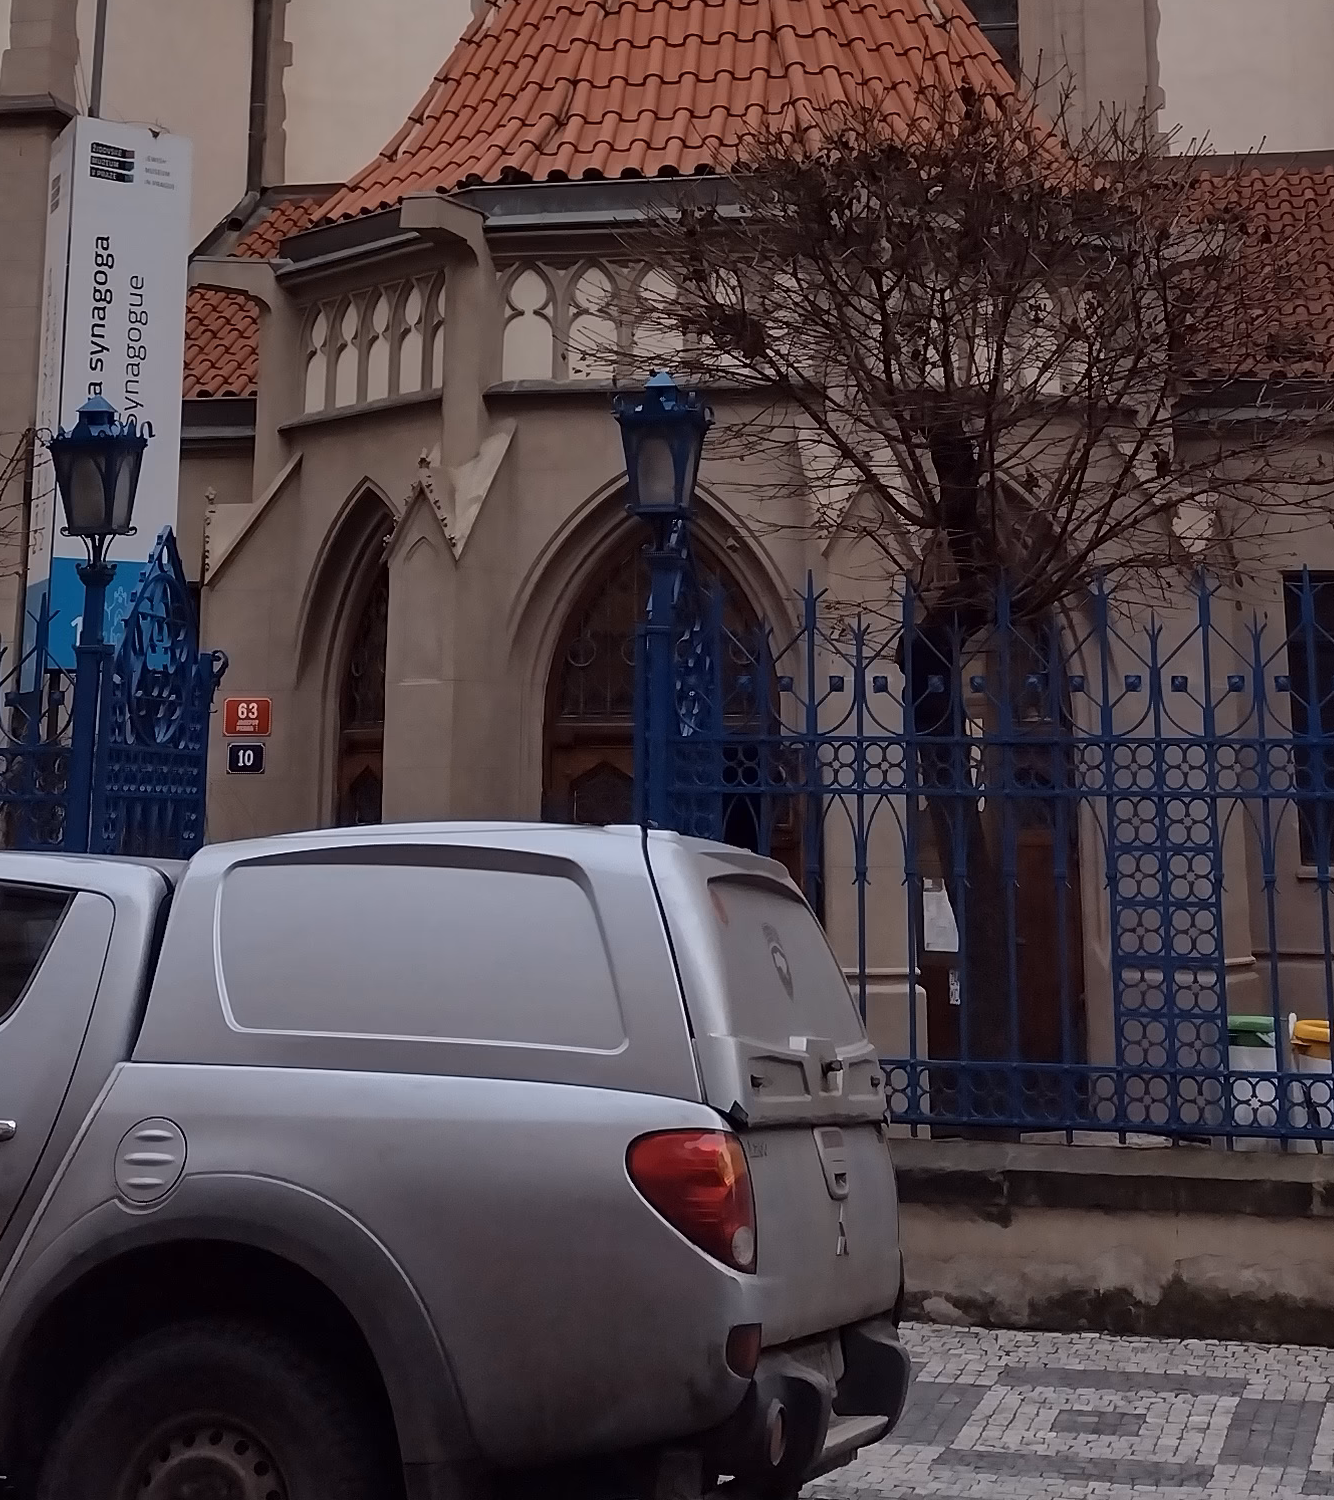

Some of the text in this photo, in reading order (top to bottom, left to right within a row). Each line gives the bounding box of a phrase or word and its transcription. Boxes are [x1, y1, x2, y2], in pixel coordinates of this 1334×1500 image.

[89, 236, 114, 372] synagoga
[238, 702, 258, 719] 63
[237, 749, 254, 766] 10
